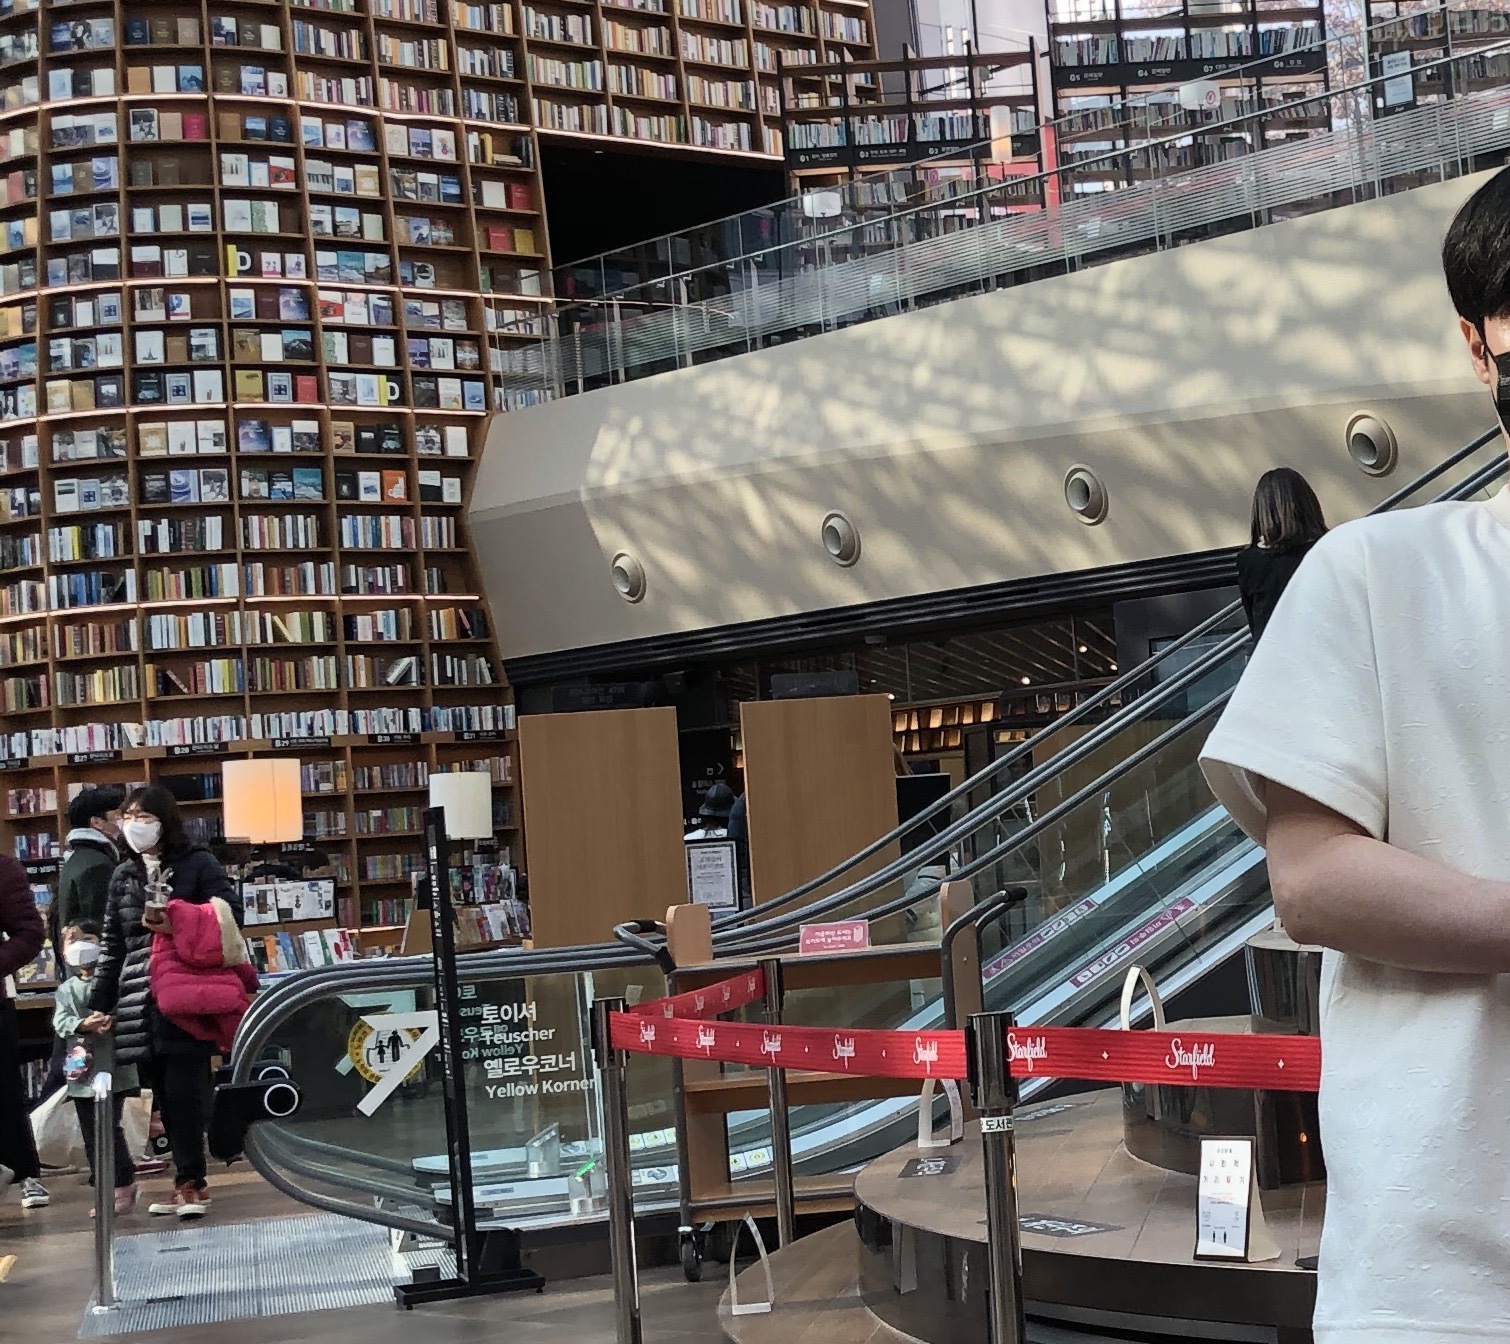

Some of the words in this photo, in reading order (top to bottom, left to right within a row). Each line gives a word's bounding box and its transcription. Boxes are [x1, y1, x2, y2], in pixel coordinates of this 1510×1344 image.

[480, 1001, 537, 1025] 토이셔
[486, 1026, 556, 1045] Teuscher
[483, 1050, 576, 1080] 옐로우코너
[1006, 1032, 1048, 1072] Starfield
[1165, 1037, 1216, 1080] Starfield
[485, 1081, 538, 1099] Yellow
[542, 1078, 596, 1095] Korner
